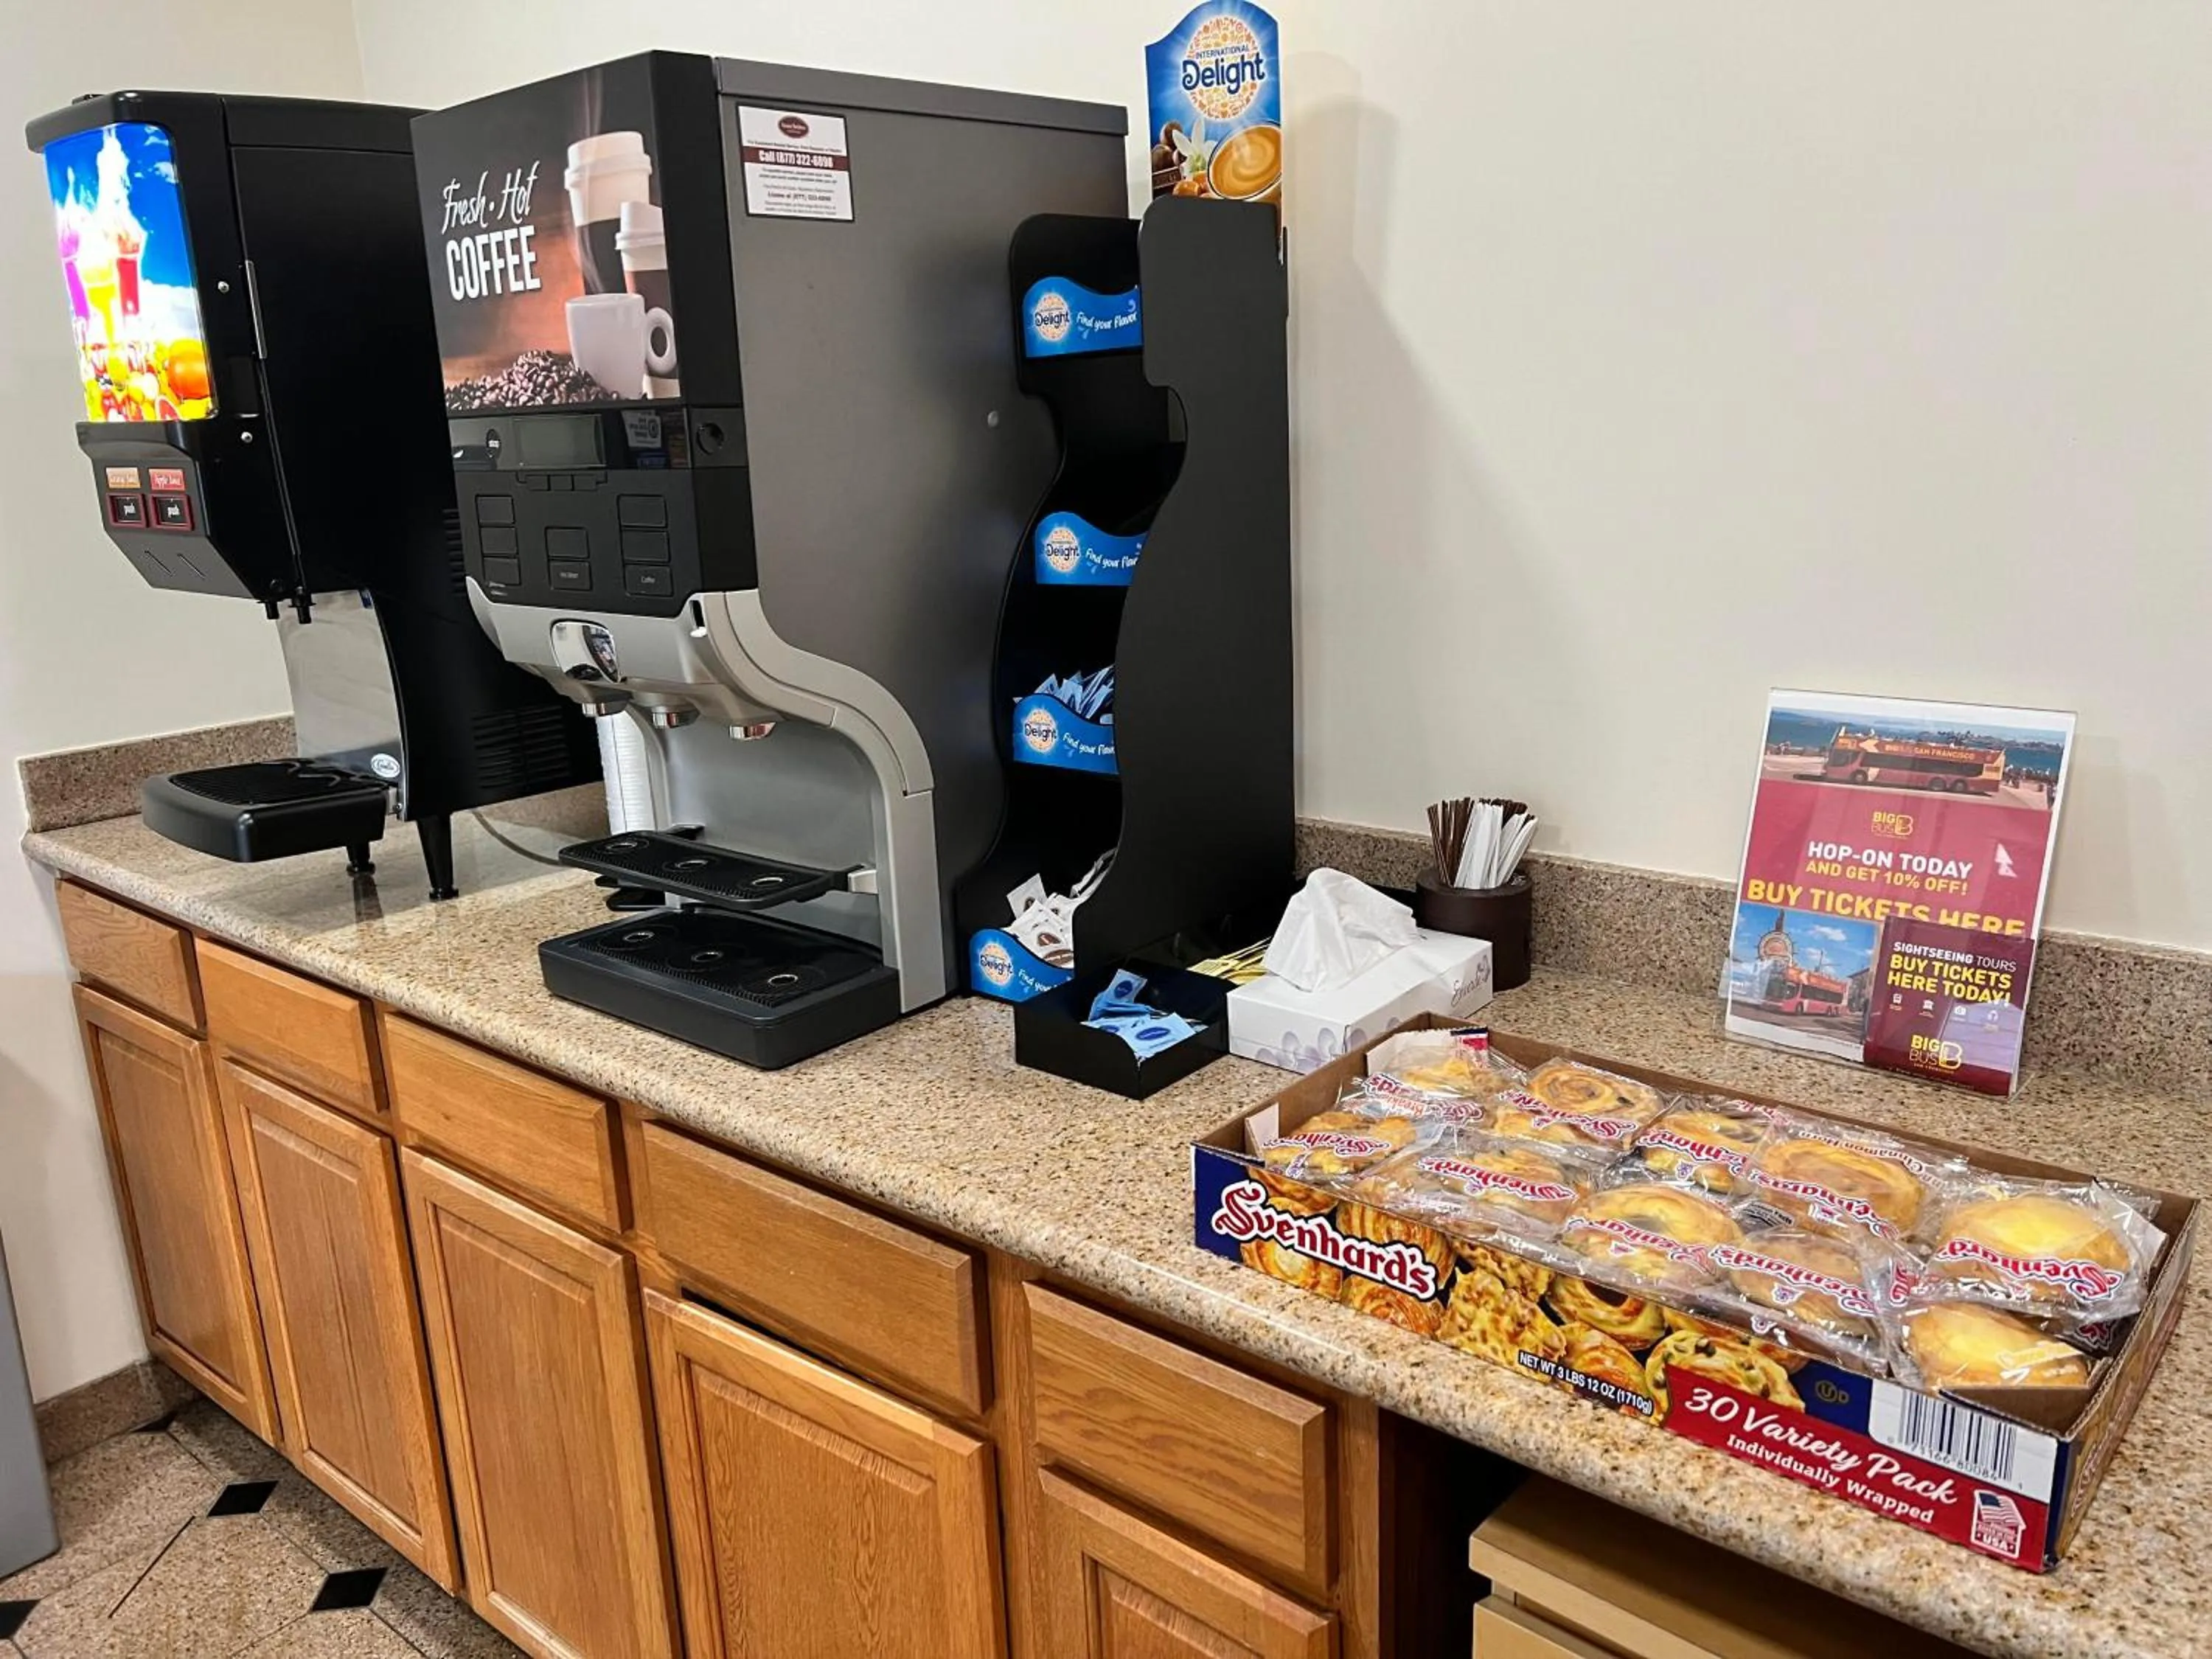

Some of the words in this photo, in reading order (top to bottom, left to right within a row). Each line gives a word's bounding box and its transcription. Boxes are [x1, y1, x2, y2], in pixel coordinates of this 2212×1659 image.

[1195, 44, 1249, 59] INTERNATIONAL
[1182, 52, 1265, 94] Delight
[758, 150, 775, 162] Call
[442, 171, 489, 235] Fresh
[497, 161, 540, 224] Hot
[446, 225, 541, 301] COFFEE
[1034, 310, 1069, 329] Delight
[1077, 311, 1094, 328] Find
[1094, 319, 1112, 332] your
[1046, 543, 1080, 560] Delight
[1085, 549, 1102, 564] Find
[1102, 558, 1119, 568] your
[1025, 723, 1057, 742] Delight
[1062, 733, 1079, 748] Find
[1079, 743, 1097, 754] your
[1873, 811, 1895, 824] BIG
[1807, 841, 1893, 869] HOP-ON
[1899, 852, 1973, 880] TODAY
[1805, 860, 1841, 877] AND
[1846, 865, 1880, 883] GET
[1885, 872, 1921, 889] 10%
[1924, 877, 1969, 896] OFF!
[1747, 880, 1804, 905] BUY
[1809, 888, 1932, 922] TICKETS
[1938, 908, 2026, 936] HERE
[1890, 954, 1928, 972] BUY
[1932, 961, 2012, 989] TICKETS
[1893, 942, 1974, 964] SIGHTSEEING
[1974, 955, 2017, 973] TOURS
[1887, 970, 1938, 992] HERE
[1942, 980, 2011, 1006] TODAY!
[1909, 1049, 1938, 1065] BUS
[1911, 1034, 1939, 1052] BIG
[1843, 1141, 1923, 1175] Cinnamon
[1214, 1185, 1430, 1295] Svenhard's
[1933, 1239, 2119, 1297] Svenhard'
[1520, 1352, 1539, 1369] NET
[1540, 1358, 1557, 1375] WT
[1557, 1366, 1565, 1379] 3
[1565, 1368, 1586, 1386] LBS
[1587, 1377, 1599, 1392] 12
[1600, 1382, 1615, 1399] OZ
[1616, 1388, 1653, 1415] (1710g)
[1684, 1387, 1740, 1423] 30
[1741, 1406, 1862, 1472] Variety
[1867, 1452, 1958, 1505] Pack
[1727, 1434, 1840, 1488] Individually
[1846, 1479, 1934, 1524] Wrapped
